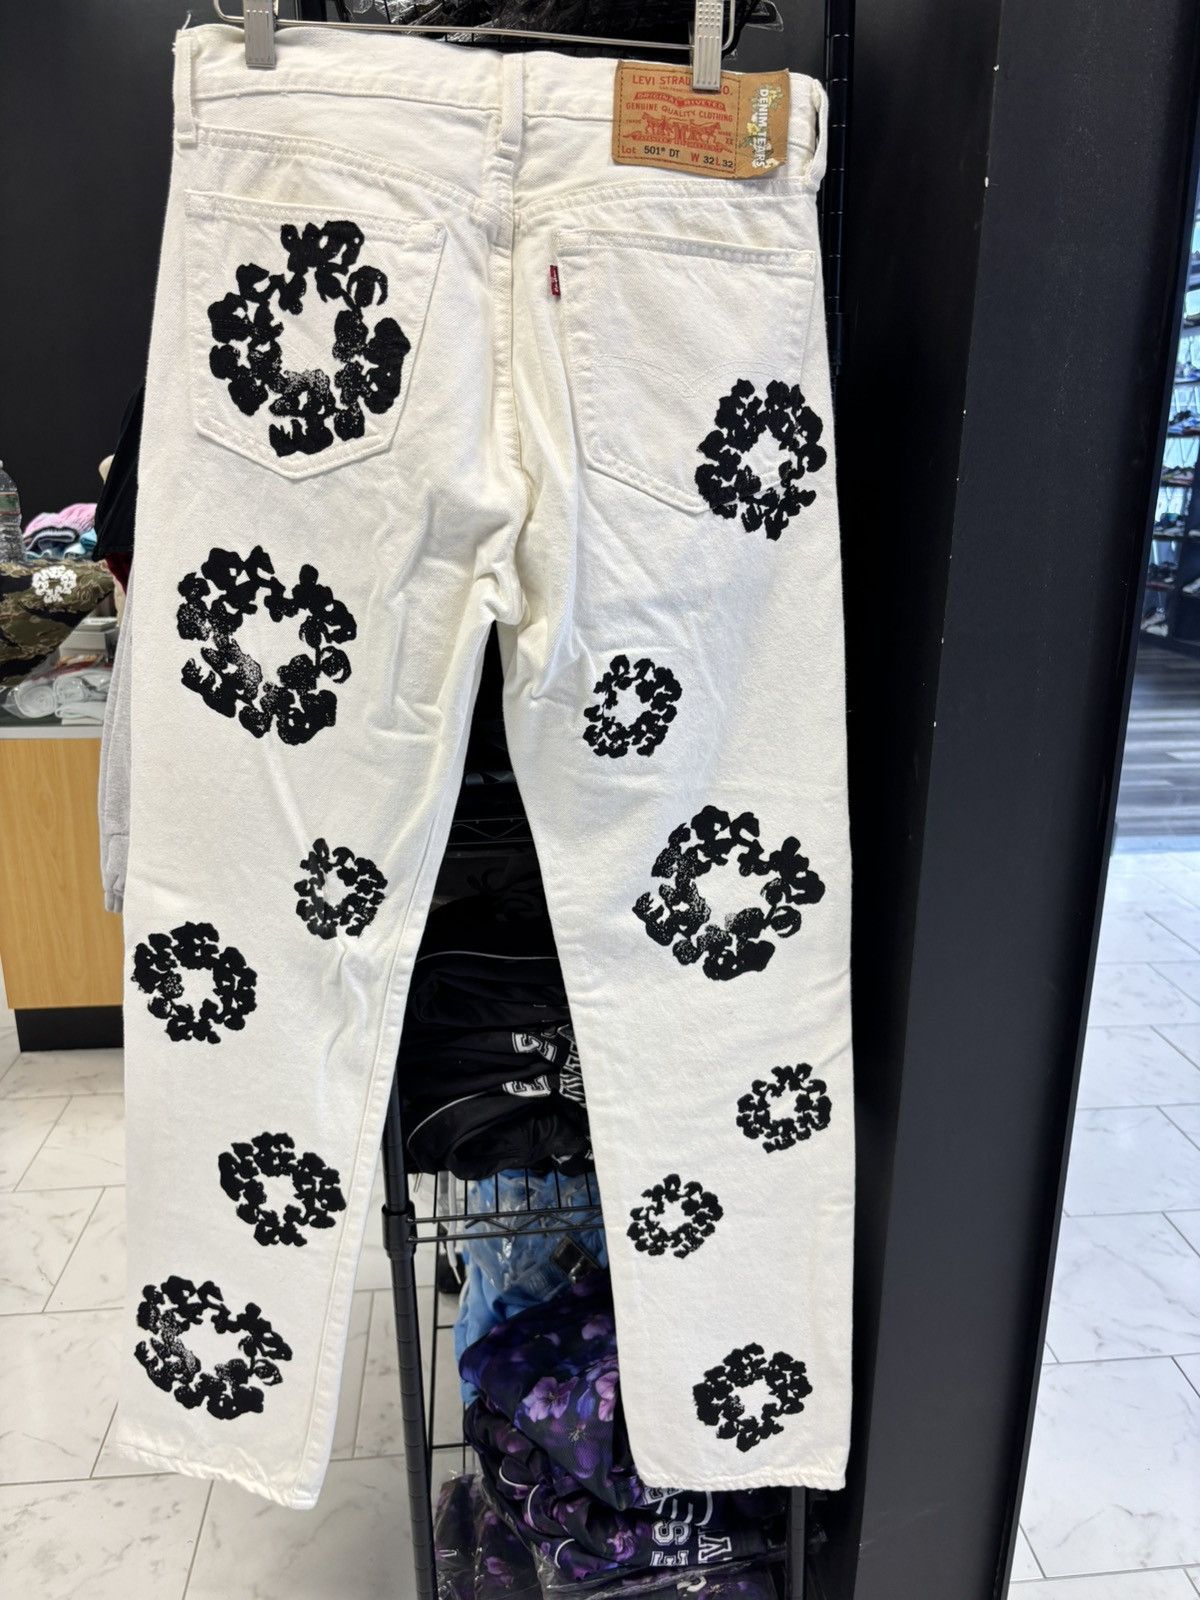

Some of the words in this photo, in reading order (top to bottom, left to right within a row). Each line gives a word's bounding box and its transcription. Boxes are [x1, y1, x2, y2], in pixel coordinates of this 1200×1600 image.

[633, 75, 655, 86] LEVI
[660, 76, 692, 86] STRAU
[626, 102, 658, 111] GENUINE
[662, 105, 696, 117] QUALITY
[699, 111, 733, 122] CLOTHING
[758, 88, 769, 127] DENIM
[621, 145, 636, 154] Lot
[669, 148, 680, 158] DT
[690, 153, 700, 162] W
[703, 155, 715, 165] 32
[721, 159, 734, 168] 32
[756, 131, 767, 168] TEARS
